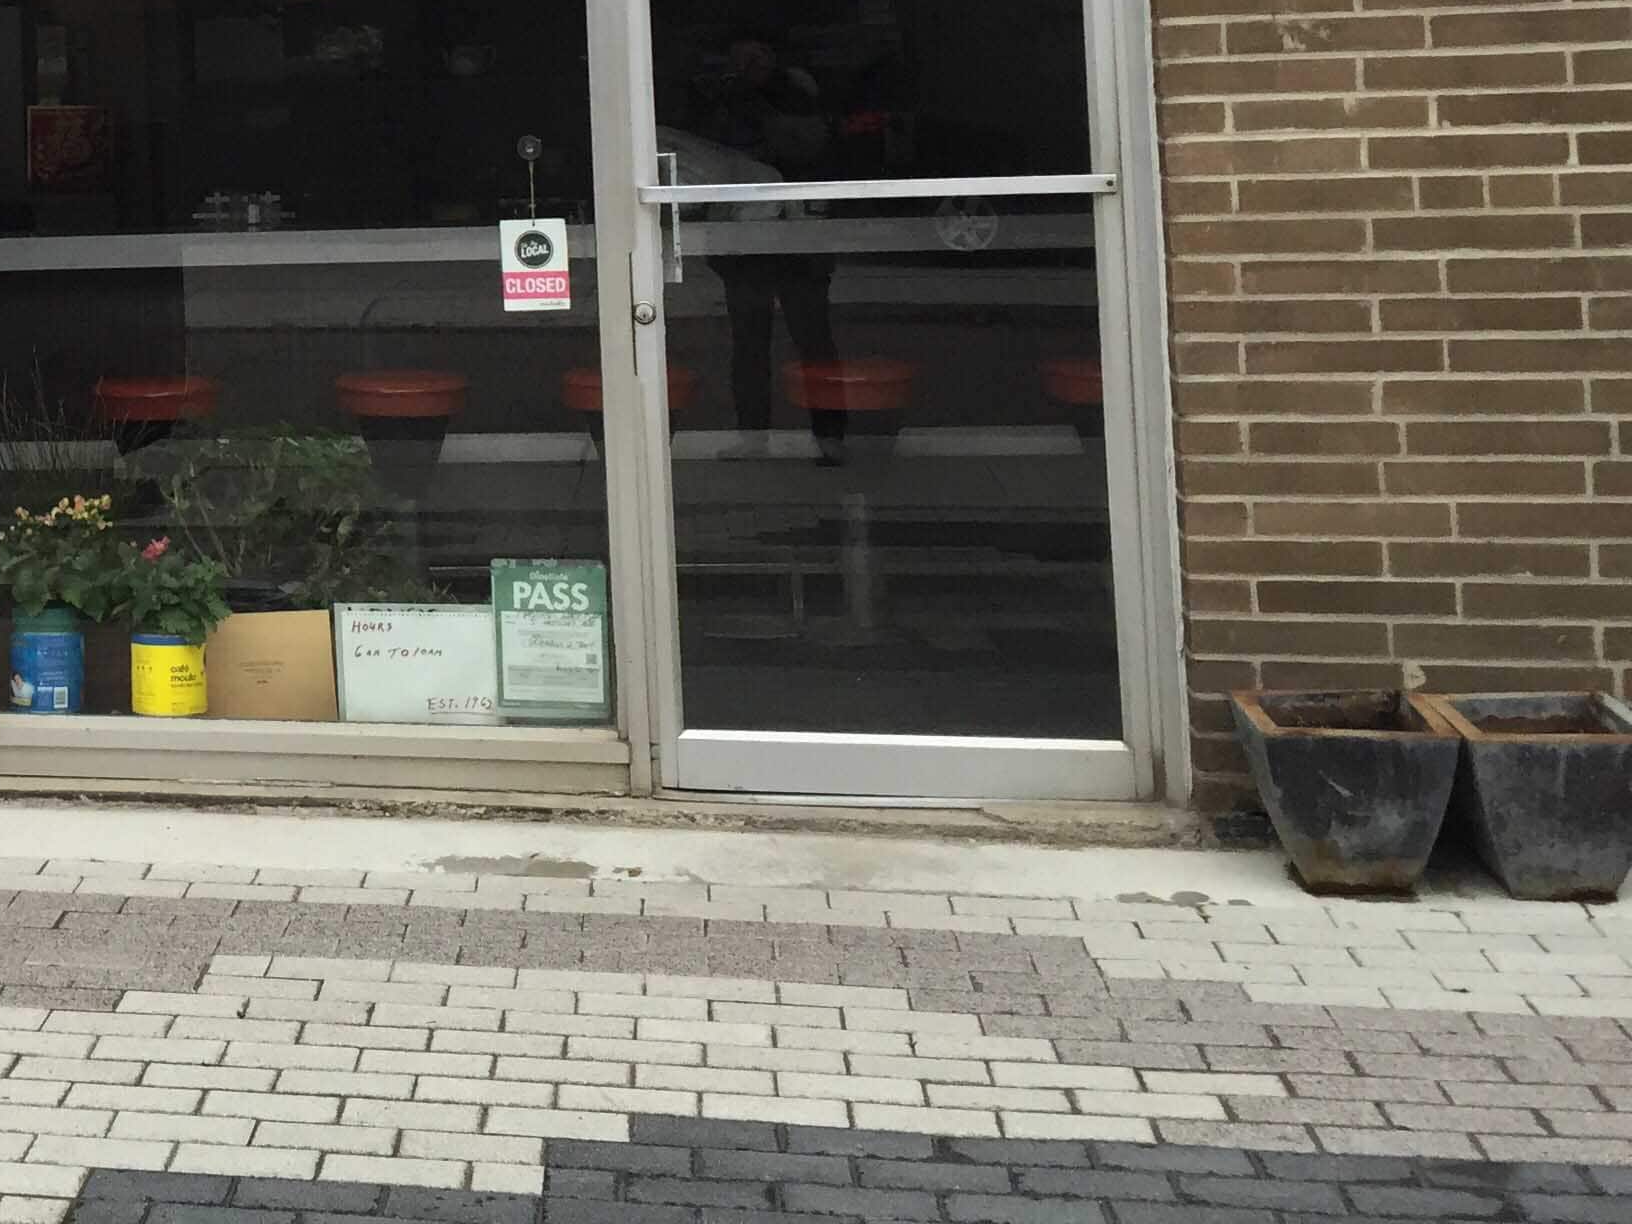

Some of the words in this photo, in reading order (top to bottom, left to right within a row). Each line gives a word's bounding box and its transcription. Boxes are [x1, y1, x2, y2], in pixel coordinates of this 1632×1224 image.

[520, 243, 549, 258] LOCAL
[505, 277, 566, 294] CLOSED
[513, 580, 590, 612] PASS
[351, 620, 393, 634] HOURS
[427, 696, 459, 710] EST.
